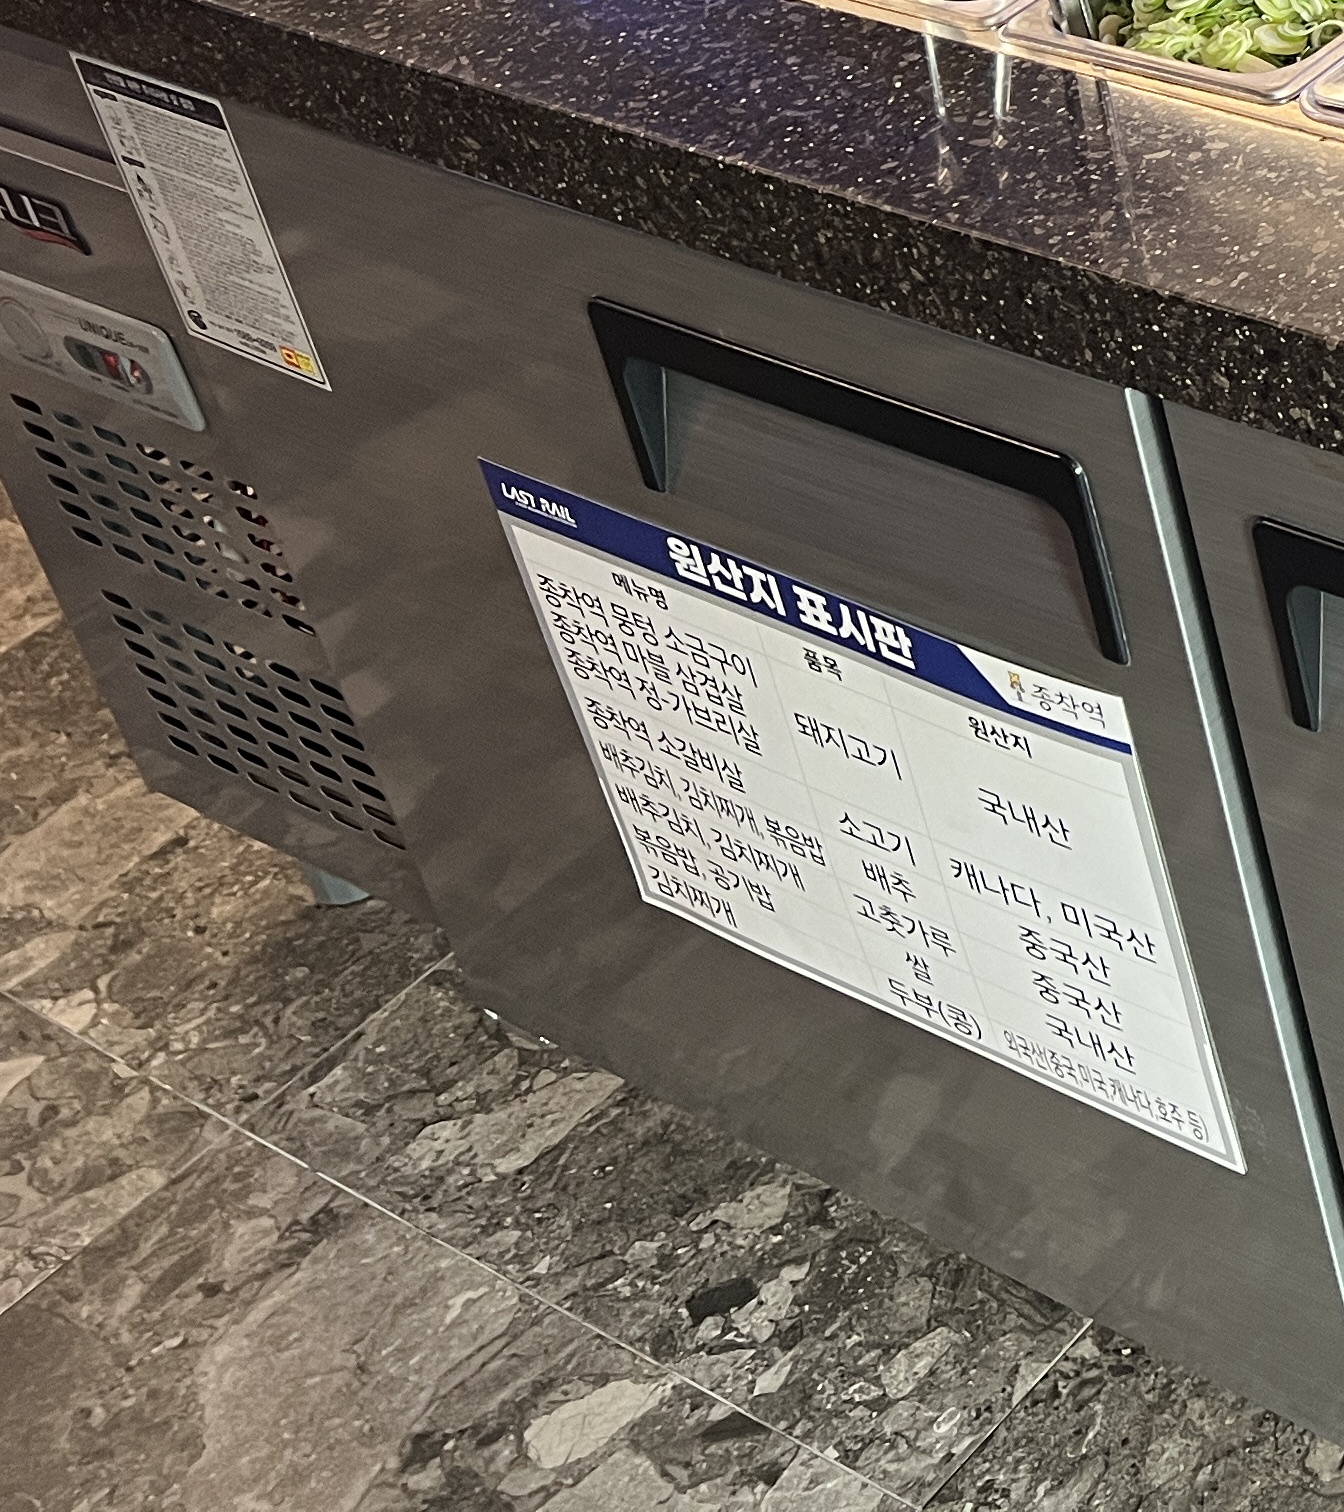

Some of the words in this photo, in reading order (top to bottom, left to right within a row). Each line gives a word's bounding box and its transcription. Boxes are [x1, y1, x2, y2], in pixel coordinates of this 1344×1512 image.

[501, 482, 536, 508] LAST
[540, 497, 576, 524] RAIL
[612, 572, 668, 610] 메뉴명
[666, 536, 786, 617] 원산지
[792, 585, 917, 670] 표시판
[536, 573, 609, 628] 종착역
[664, 626, 758, 688] 소금구이
[550, 610, 623, 664] 종착역
[622, 640, 673, 685] 마블
[676, 661, 747, 718] 삼겹살
[803, 647, 842, 681] 품목
[565, 646, 636, 701] 종착역
[634, 675, 763, 756] 정-가브리살
[1031, 683, 1106, 729] 종착역
[584, 696, 654, 751] 종착역
[658, 731, 746, 794] 소갈비살
[794, 711, 902, 781] 돼지고기
[968, 716, 1032, 759] 원산지
[599, 740, 682, 801] 배추김치,
[680, 777, 765, 840] 김치찌개,
[764, 815, 826, 867] 볶음밥
[978, 787, 1072, 851] 국내산
[615, 783, 711, 850] 배추김치,
[710, 827, 806, 892] 김치찌개
[632, 824, 706, 881] 볶음밥,
[707, 859, 775, 913] 공기밥
[839, 812, 916, 867] 소고기
[648, 865, 738, 929] 김치찌개
[861, 859, 917, 903] 배추
[949, 857, 1052, 924] 캐나다,
[1060, 901, 1157, 965] 미국산
[853, 893, 957, 957] 고춧가루
[1018, 925, 1112, 987] 중국산
[906, 951, 935, 986] 쌀
[888, 977, 982, 1041] 두부(콩)
[1031, 970, 1124, 1032] 중국산
[1045, 1013, 1137, 1076] 국내산
